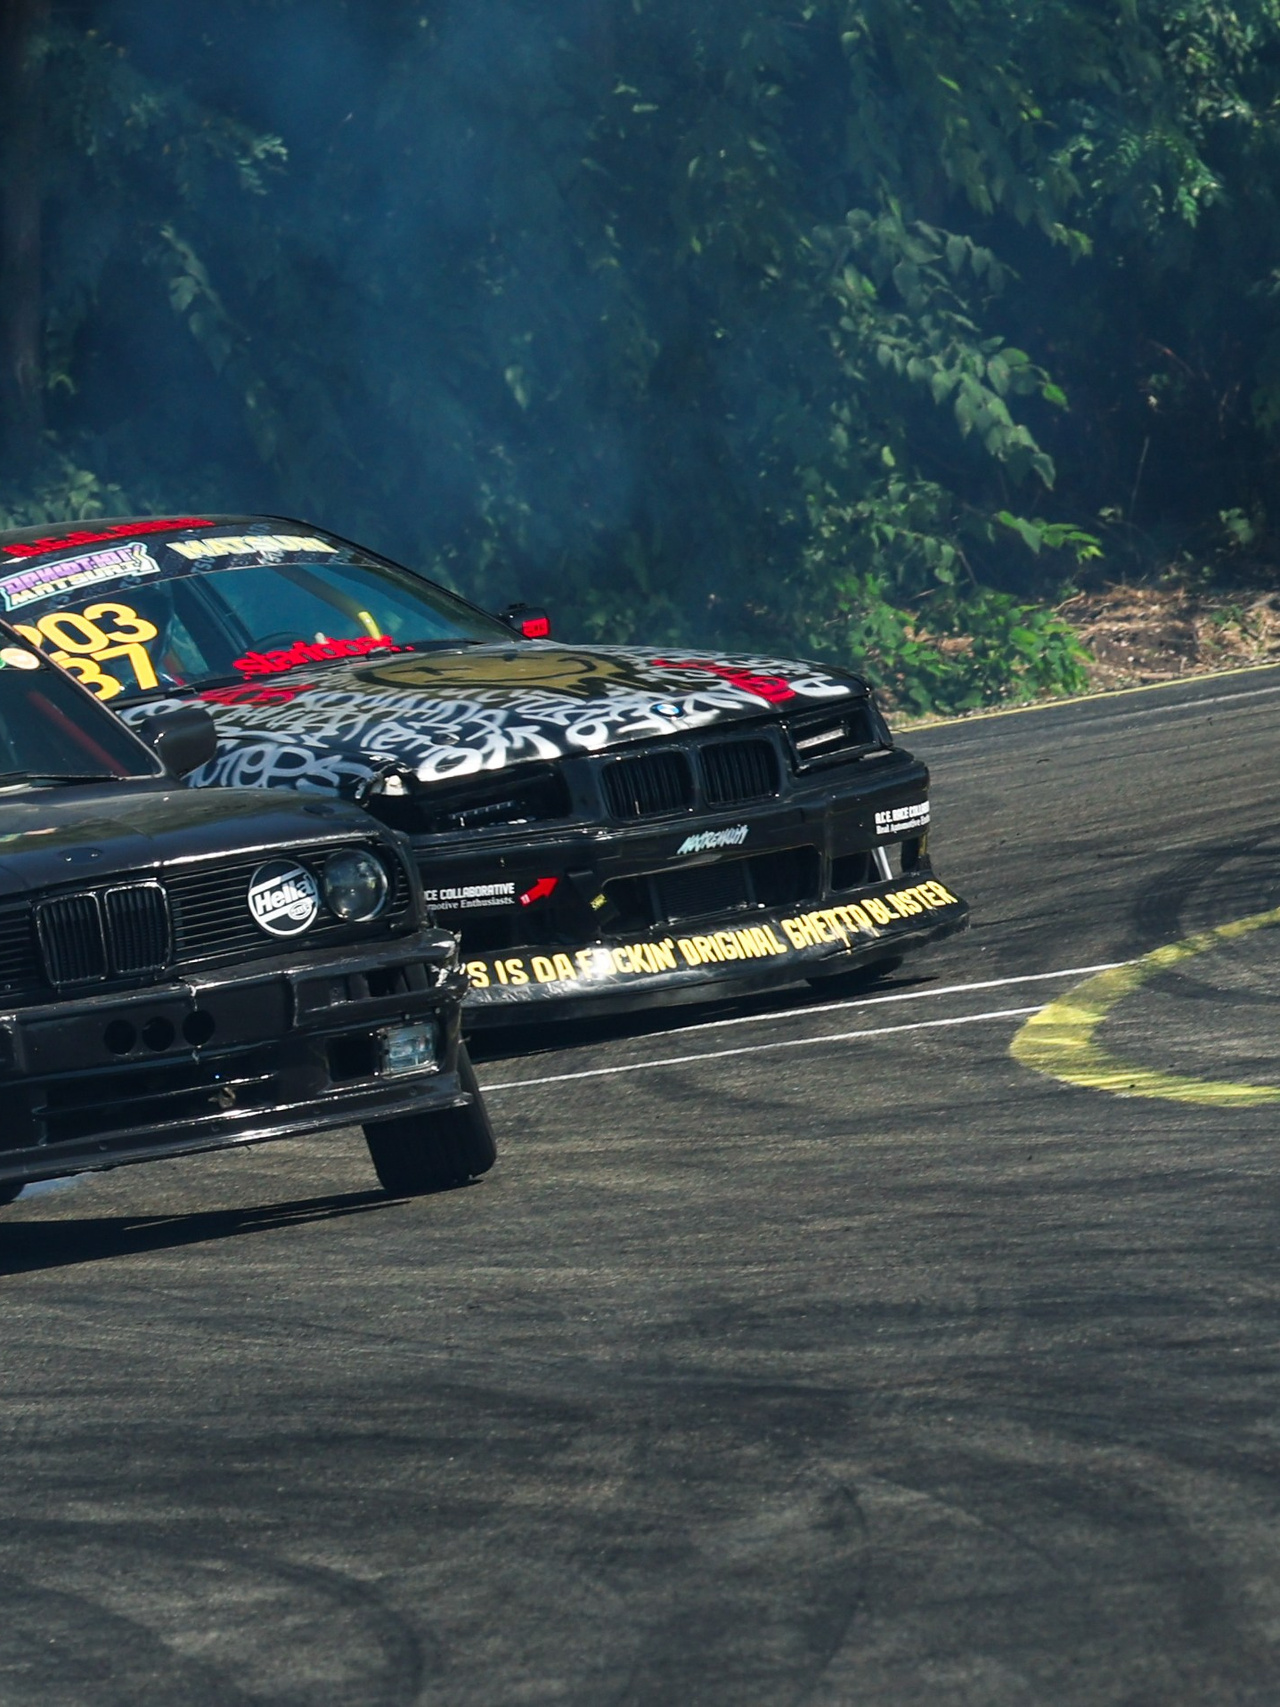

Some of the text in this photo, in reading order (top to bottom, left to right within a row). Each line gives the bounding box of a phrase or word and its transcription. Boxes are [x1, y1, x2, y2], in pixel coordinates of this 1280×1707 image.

[166, 534, 340, 561] MATSURI
[10, 560, 140, 605] MATSURI
[255, 880, 314, 915] Hella
[440, 882, 516, 900] COLLABORATIVE
[460, 896, 515, 908] Enthusiasts.
[494, 958, 530, 986] IS
[531, 953, 578, 983] DA
[677, 924, 788, 967] ORIGINAL
[780, 904, 874, 950] GHETTO
[860, 880, 959, 926] BLASTER
